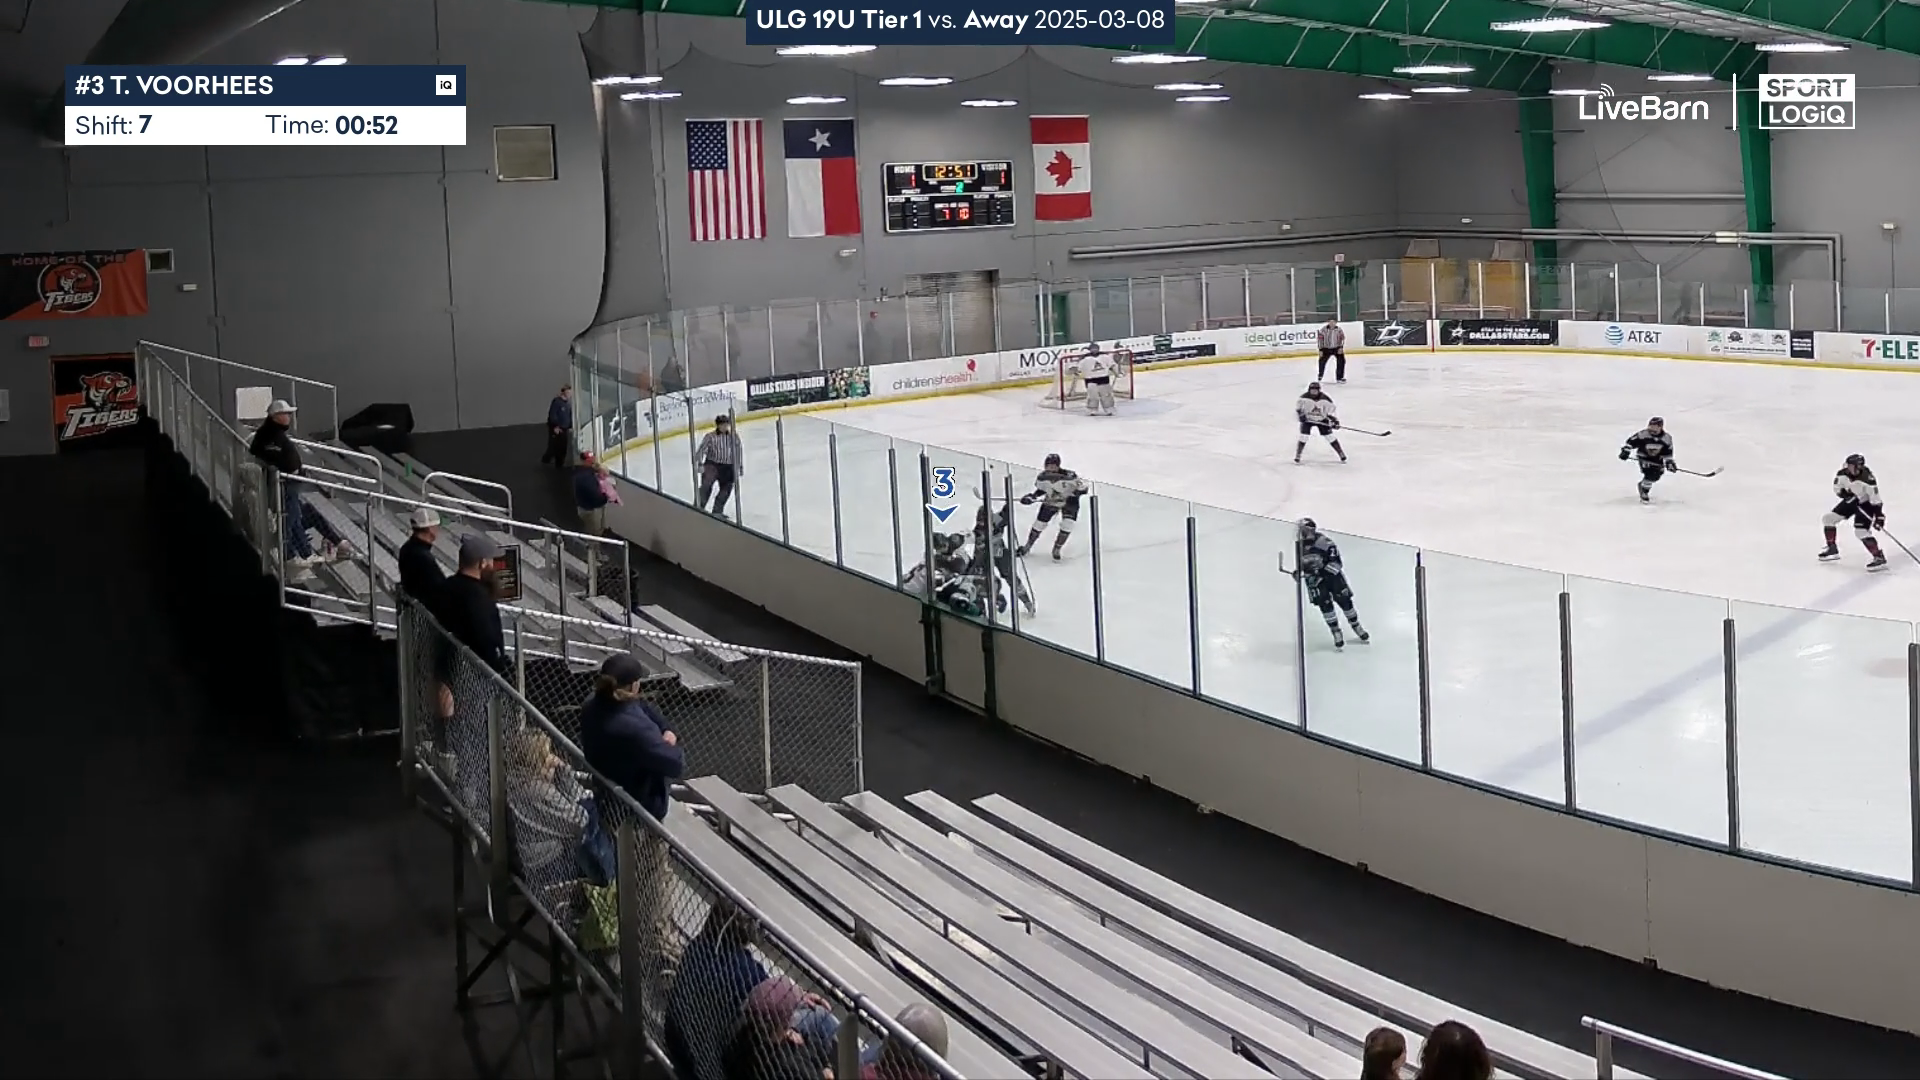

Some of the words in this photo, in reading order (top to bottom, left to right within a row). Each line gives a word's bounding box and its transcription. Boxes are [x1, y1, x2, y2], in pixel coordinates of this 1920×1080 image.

[935, 165, 971, 178] 12:51
[955, 181, 965, 194] 2
[941, 208, 950, 220] 7
[12, 256, 58, 267] HOME
[66, 254, 87, 265] OF
[95, 253, 126, 264] THE
[1244, 332, 1277, 344] ideal
[1627, 330, 1662, 344] AT&T
